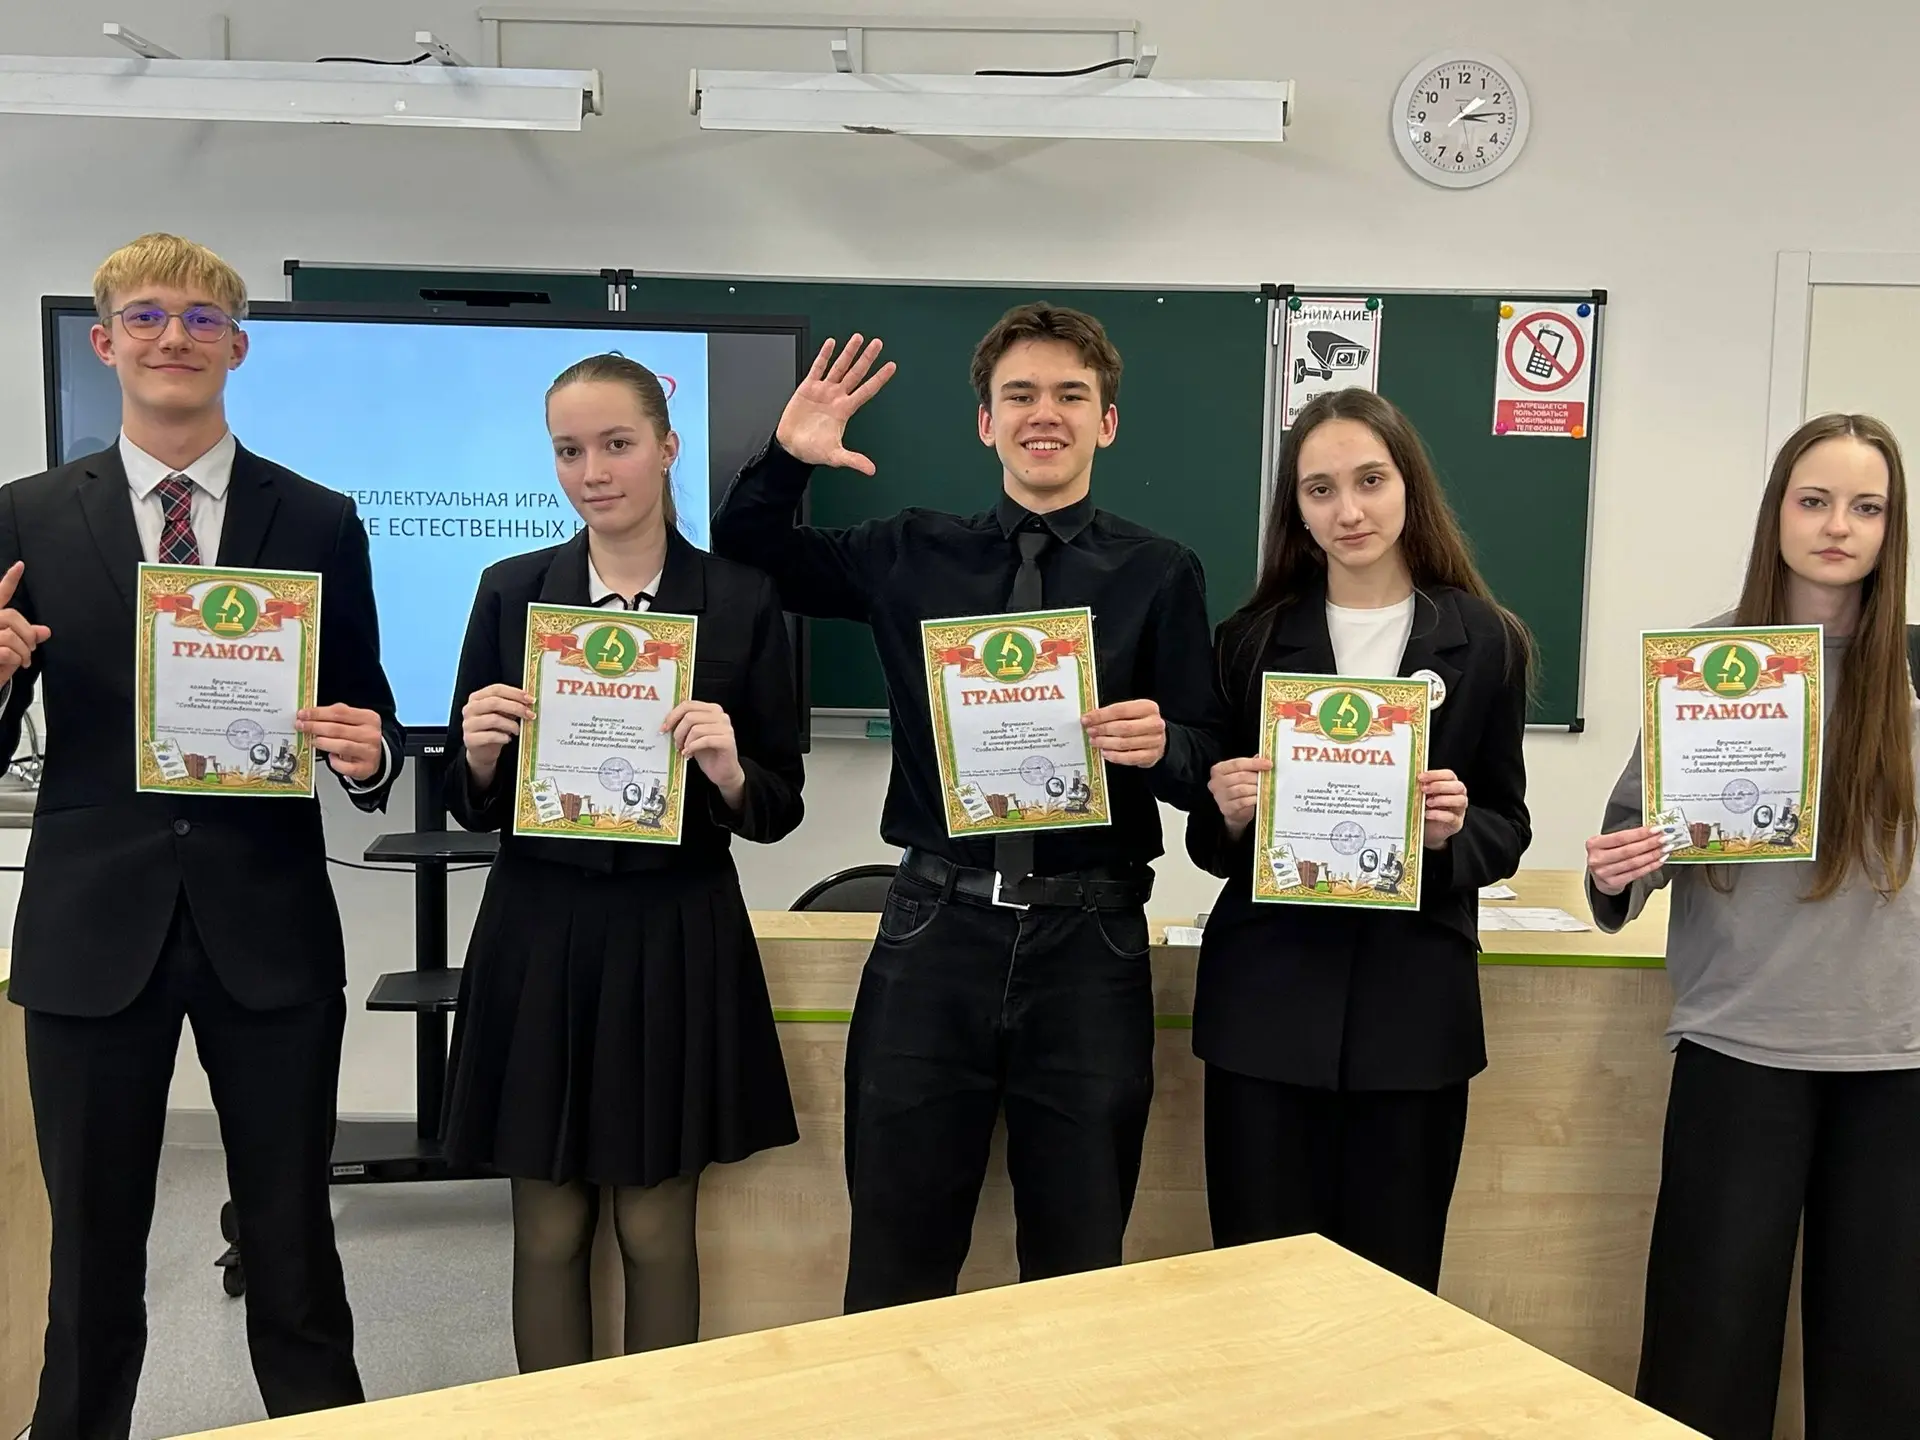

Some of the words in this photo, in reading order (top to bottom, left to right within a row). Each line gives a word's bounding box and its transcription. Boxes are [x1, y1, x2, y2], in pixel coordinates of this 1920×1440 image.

[1439, 77, 1450, 89] 11
[1458, 72, 1471, 84] 12
[1481, 78, 1486, 90] 1
[1425, 91, 1439, 104] 10
[1492, 92, 1501, 104] 2
[1417, 111, 1426, 123] 9
[1497, 112, 1506, 124] 3
[1423, 131, 1431, 143] 8
[1489, 132, 1498, 144] 4
[1438, 146, 1446, 157] 7
[1455, 151, 1464, 163] 6
[1475, 146, 1484, 158] 5
[1515, 402, 1568, 410] ЗАПРЕЩАЕТСЯ
[1513, 409, 1569, 417] ПОЛЬЗОВАТЬСЯ
[1515, 417, 1566, 425] МОБИЛЬНЫМИ
[1516, 424, 1565, 432] ТЕЛЕФОНАМИ
[345, 490, 508, 507] ТЕЛЛЕКТУАЛЬНАЯ
[515, 493, 560, 508] ИГРА
[389, 517, 566, 539] ЕСТЕСТВЕННЫХ
[172, 641, 285, 662] ГРАМОТА
[556, 678, 660, 701] ГРАМОТА
[961, 684, 1065, 706] ГРАМОТА
[1675, 702, 1789, 721] ГРАМОТА
[1291, 745, 1396, 766] ГРАМОТА
